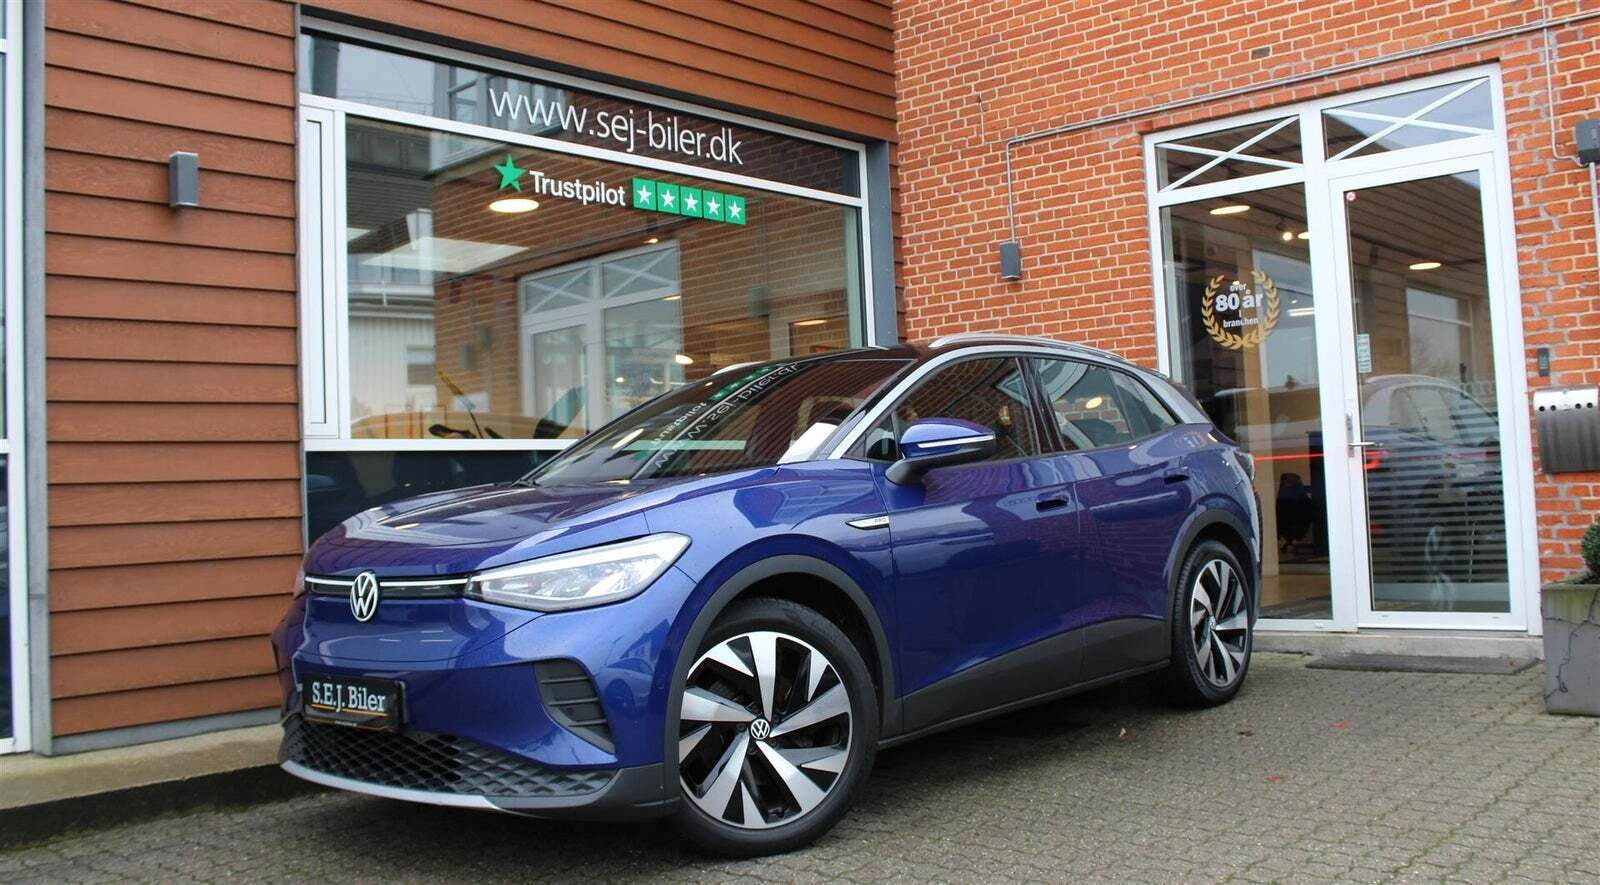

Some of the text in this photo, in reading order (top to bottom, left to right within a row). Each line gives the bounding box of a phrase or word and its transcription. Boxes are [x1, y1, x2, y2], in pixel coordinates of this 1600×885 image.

[489, 88, 743, 165] www.sej-biler.dk
[529, 170, 626, 206] Trustpilot
[1215, 289, 1263, 312] 80 år
[1230, 284, 1247, 292] over
[1223, 318, 1259, 328] branchen
[312, 681, 386, 712] S.E.J. Biler
